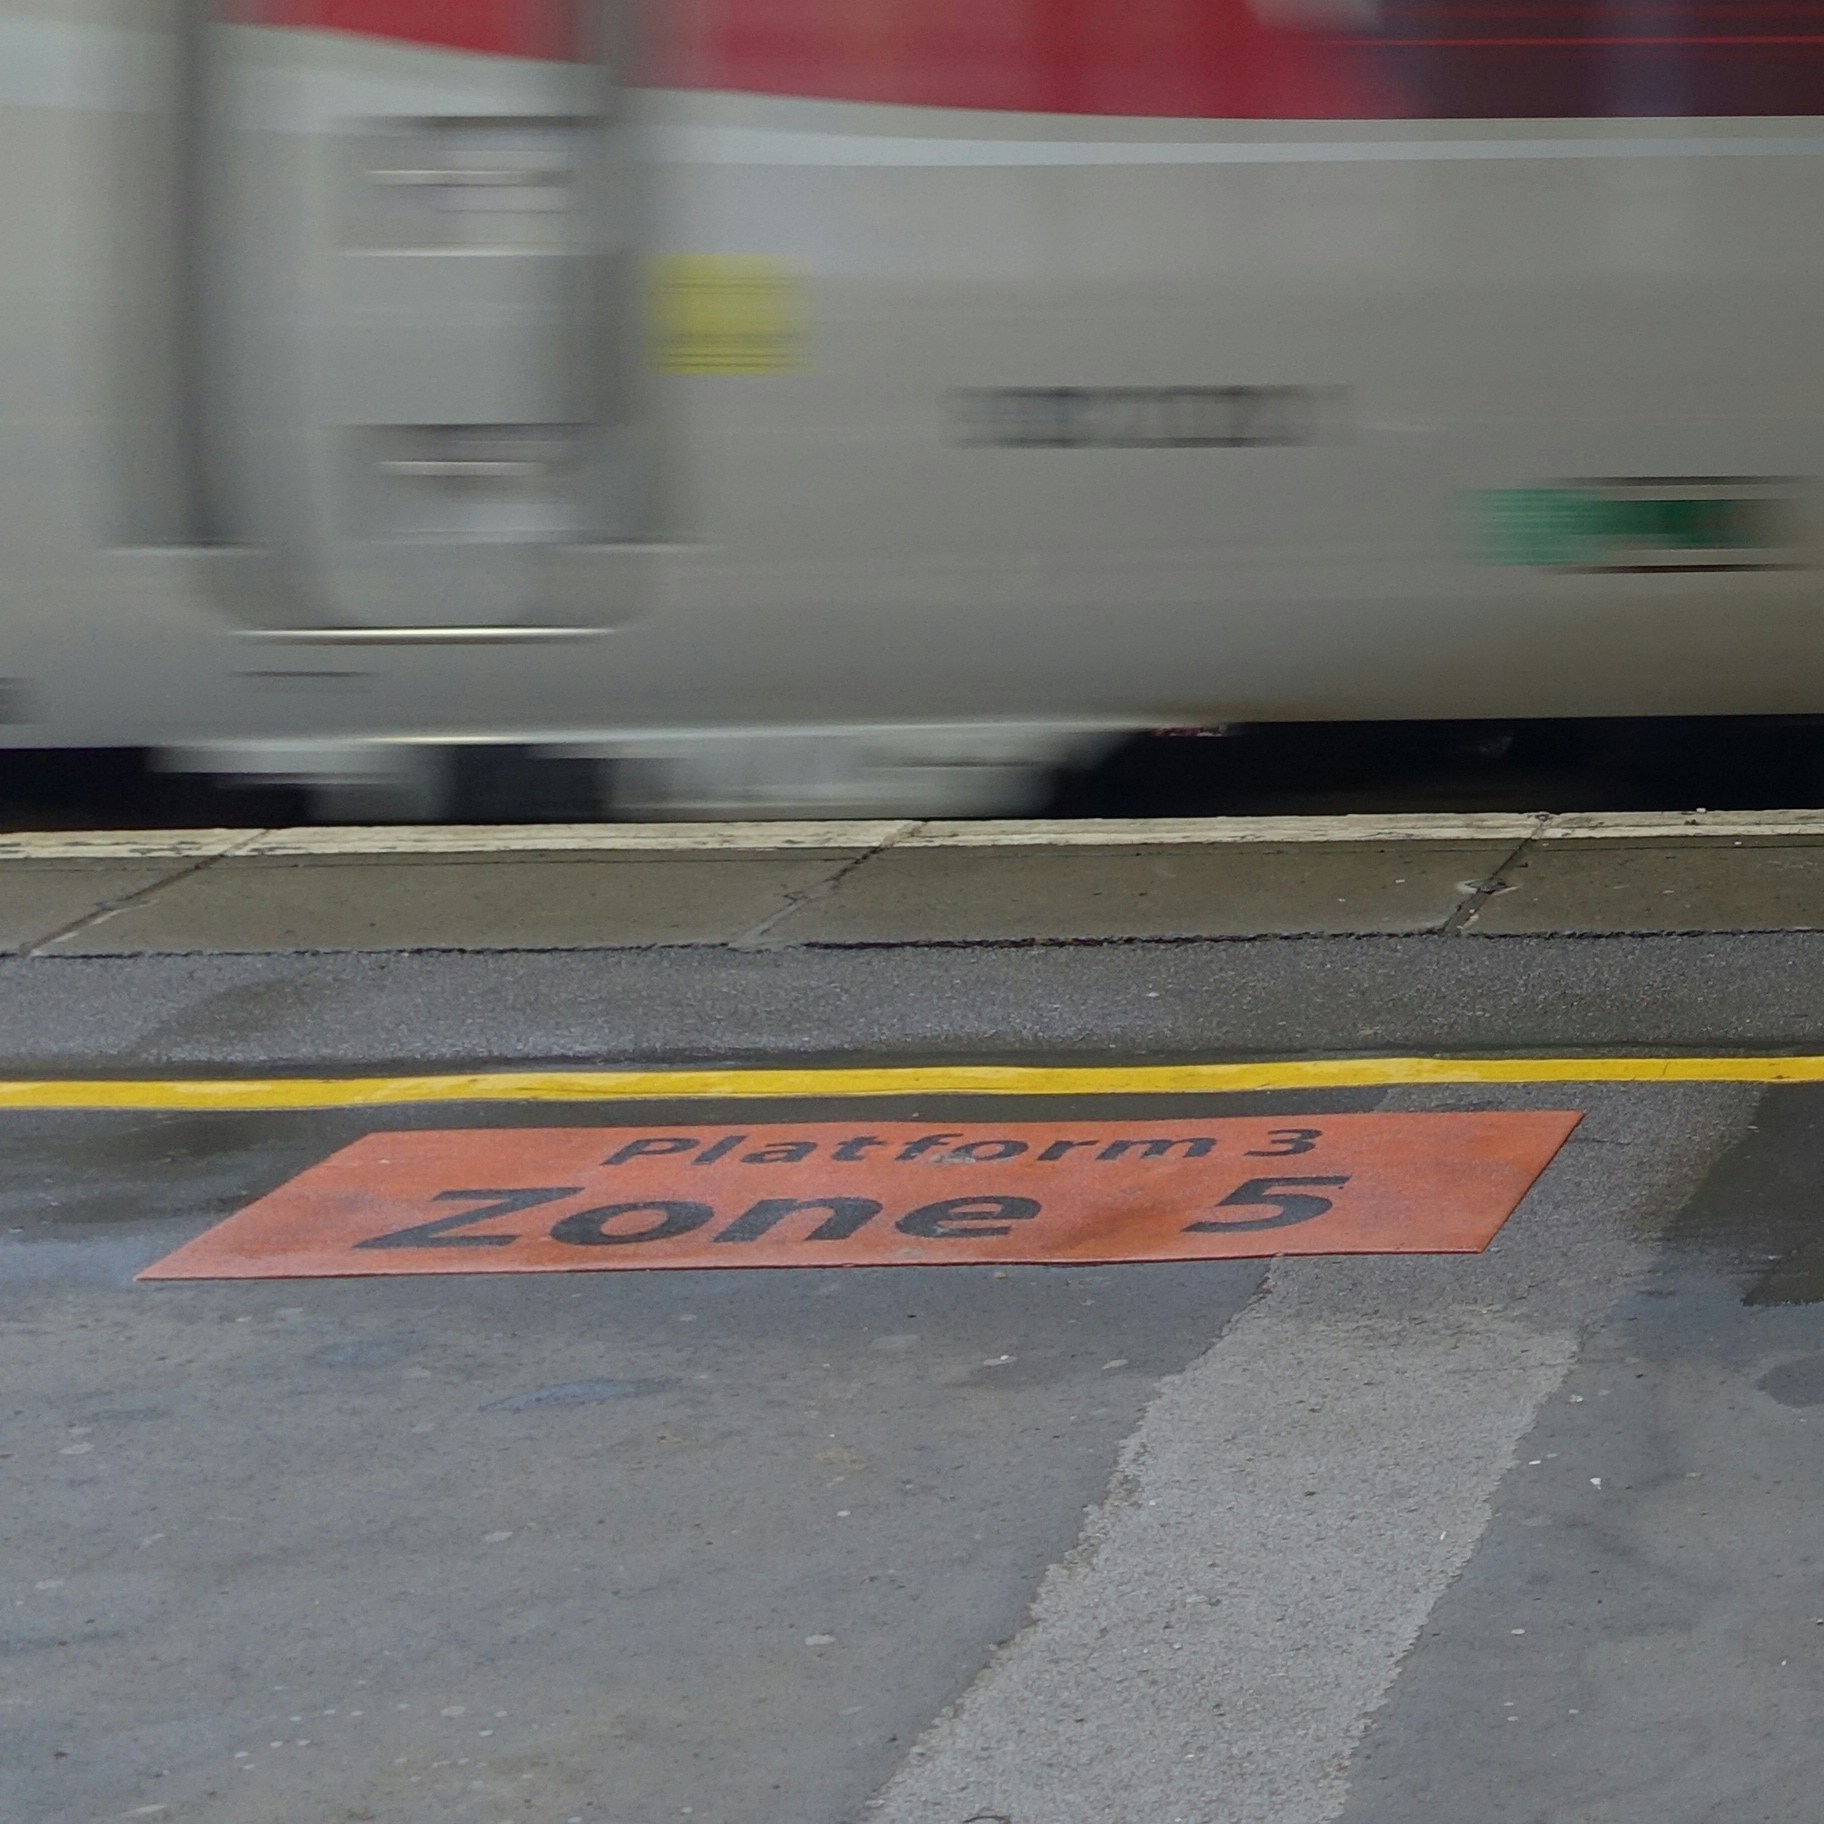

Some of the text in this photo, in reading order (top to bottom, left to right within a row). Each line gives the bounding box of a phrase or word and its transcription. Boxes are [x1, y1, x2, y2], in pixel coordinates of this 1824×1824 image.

[600, 1129, 1324, 1167] Platform 3
[351, 1174, 1353, 1249] Zone 5
